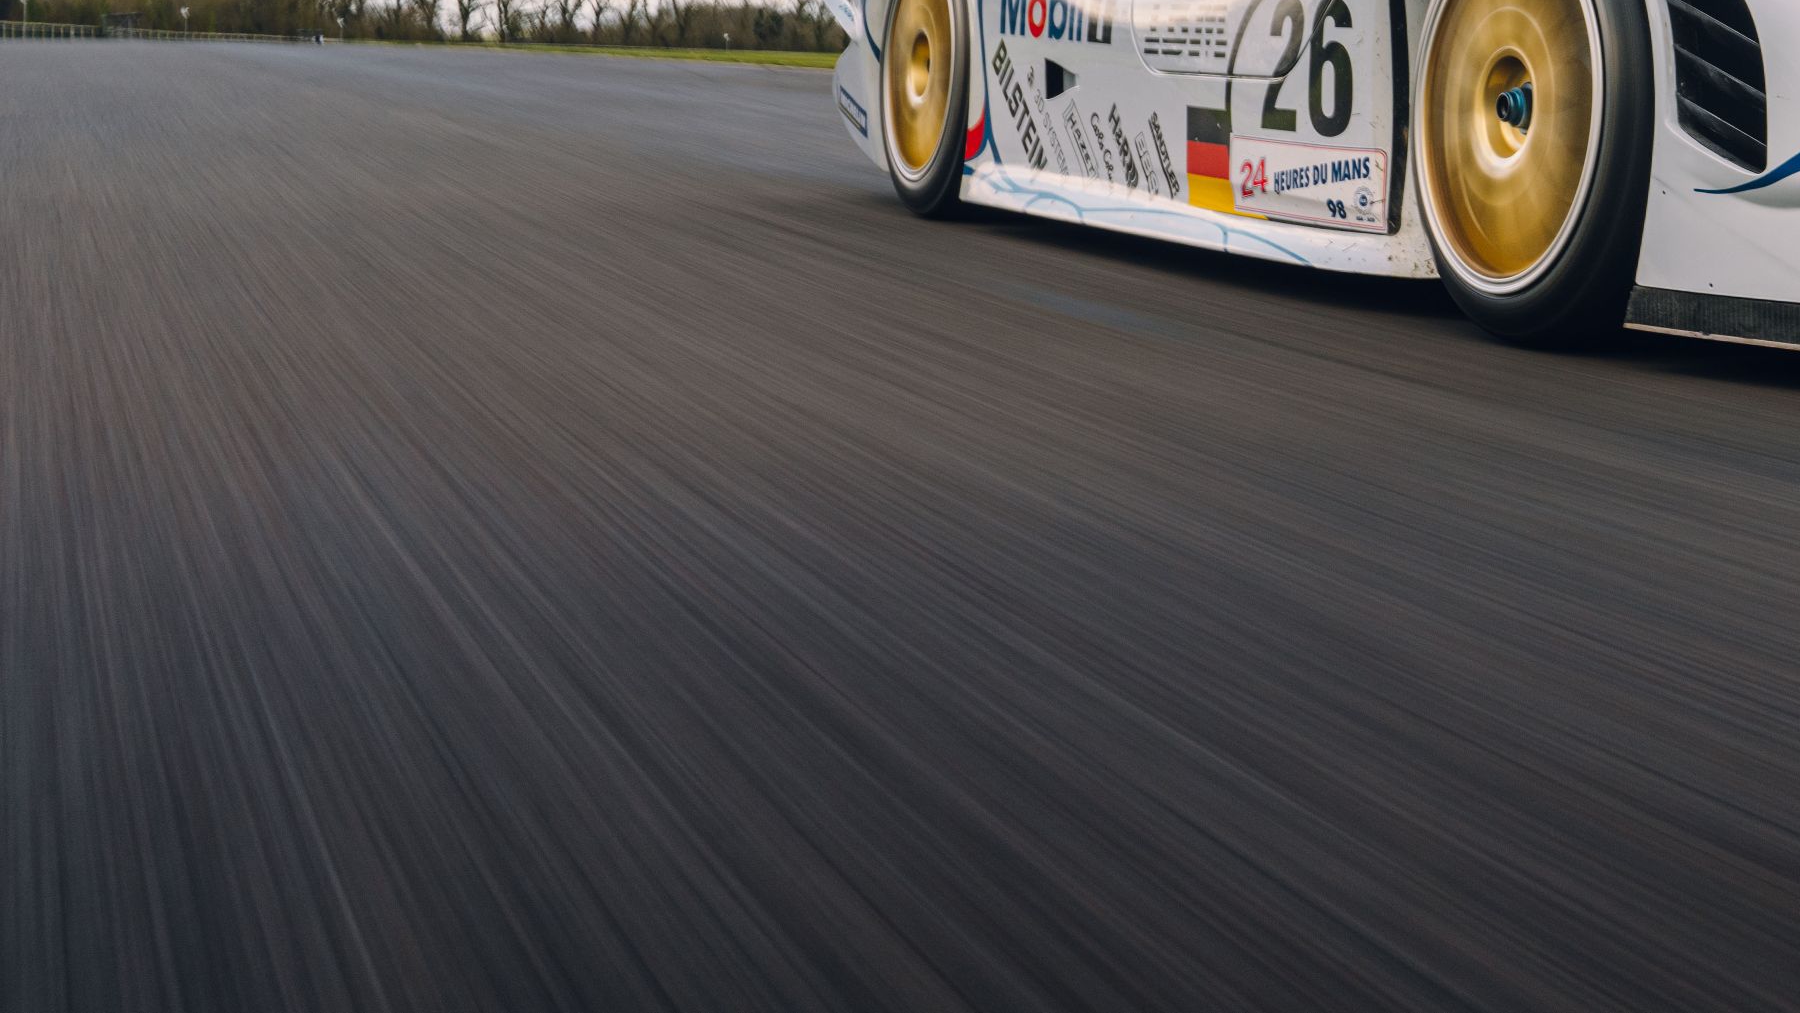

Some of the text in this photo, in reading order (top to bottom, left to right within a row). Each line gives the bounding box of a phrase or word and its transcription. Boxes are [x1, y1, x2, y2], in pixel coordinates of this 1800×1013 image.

[992, 37, 1049, 176] BILSTEIN
[1240, 157, 1370, 197] 24 HEURES DU MANS
[1327, 199, 1347, 219] 98
